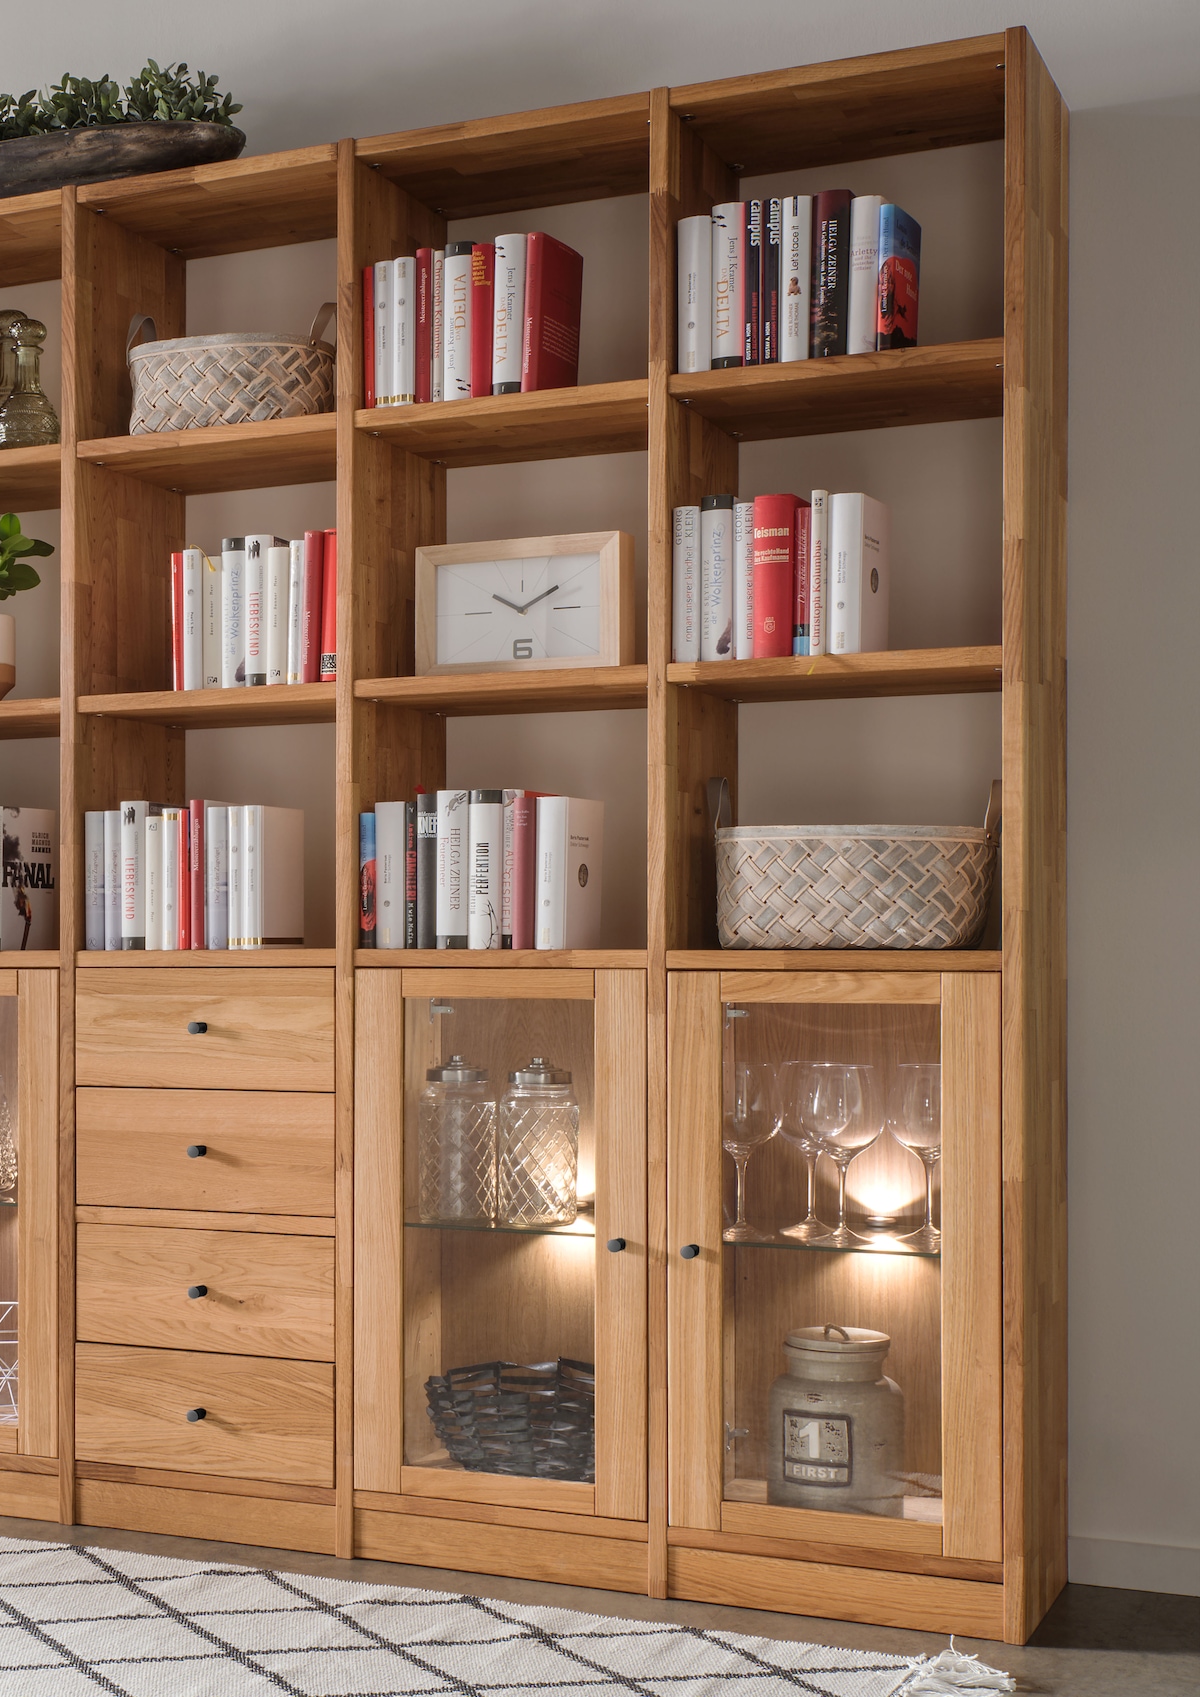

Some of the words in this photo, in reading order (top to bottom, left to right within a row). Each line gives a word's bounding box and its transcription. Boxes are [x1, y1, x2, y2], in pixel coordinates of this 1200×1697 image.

[748, 200, 761, 247] campus
[766, 198, 780, 245] campus
[828, 220, 838, 254] HELGA
[728, 236, 738, 254] Jens
[851, 248, 878, 257] Arletty
[434, 260, 444, 306] Christoph
[506, 266, 516, 283] Jens
[728, 263, 738, 293] Kramer
[827, 256, 838, 290] ZEINER
[454, 273, 467, 330] DELTA
[506, 292, 516, 321] Kramer
[716, 280, 730, 339] DELTA
[434, 308, 442, 359] Kolumbus
[496, 309, 507, 364] DELTA
[448, 351, 456, 370] Jens
[684, 509, 694, 538] KLEIN
[744, 505, 754, 535] KLEIN
[754, 526, 790, 539] Teisman
[684, 546, 692, 580] kindheit
[710, 531, 724, 608] Wolkenprinz
[744, 542, 754, 577] kindheit
[812, 540, 822, 590] Kolumbus
[230, 568, 242, 640] Wolkenprinz
[812, 596, 822, 646] Christoph
[249, 592, 260, 656] LIEBESKIND
[512, 638, 533, 660] 6
[32, 832, 49, 840] ULRICH
[450, 828, 460, 866] HELGA
[2, 862, 54, 889] FANAL
[440, 837, 449, 888] Feuermeer
[476, 842, 489, 895] PERFEKTION
[125, 857, 136, 920] LIEBESKIND
[450, 869, 460, 910] ZEINER
[502, 850, 514, 930] AUSGESPIELT
[798, 1421, 821, 1459] 1
[792, 1464, 839, 1480] FIRST
